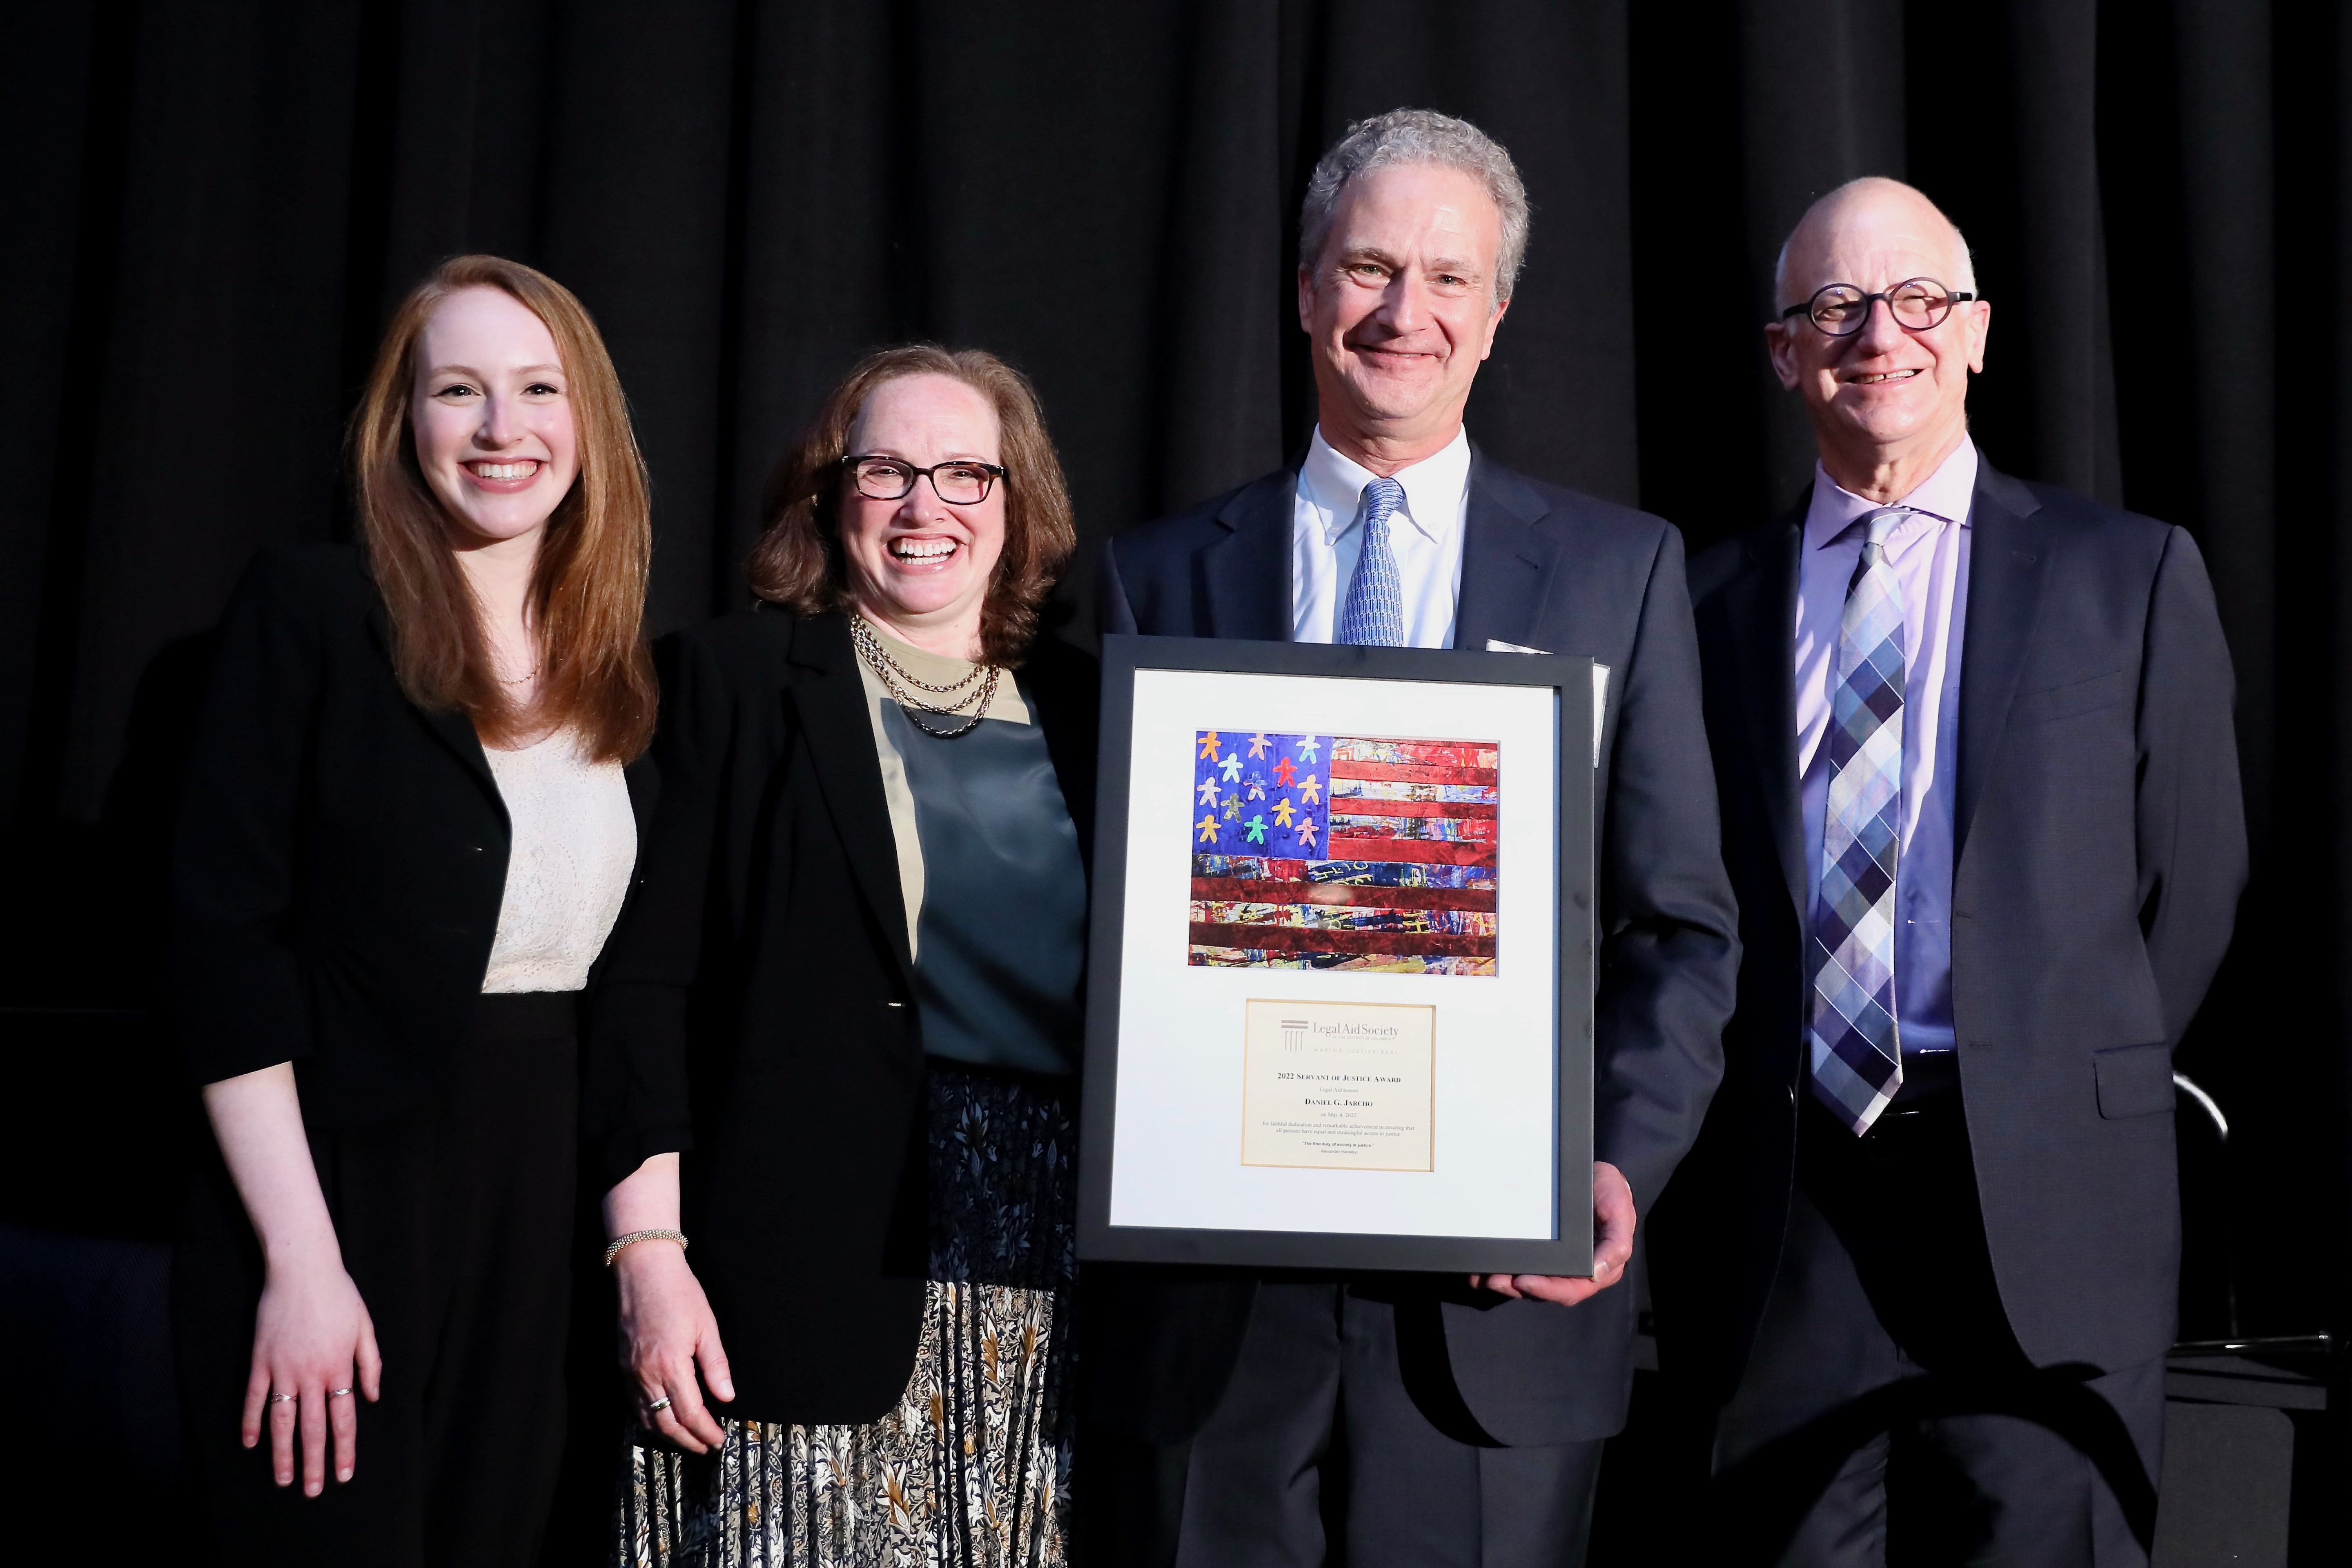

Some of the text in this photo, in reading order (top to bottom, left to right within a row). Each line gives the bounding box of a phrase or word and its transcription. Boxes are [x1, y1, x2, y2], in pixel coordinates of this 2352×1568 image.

[1313, 1022, 1399, 1039] Legal Aid Society
